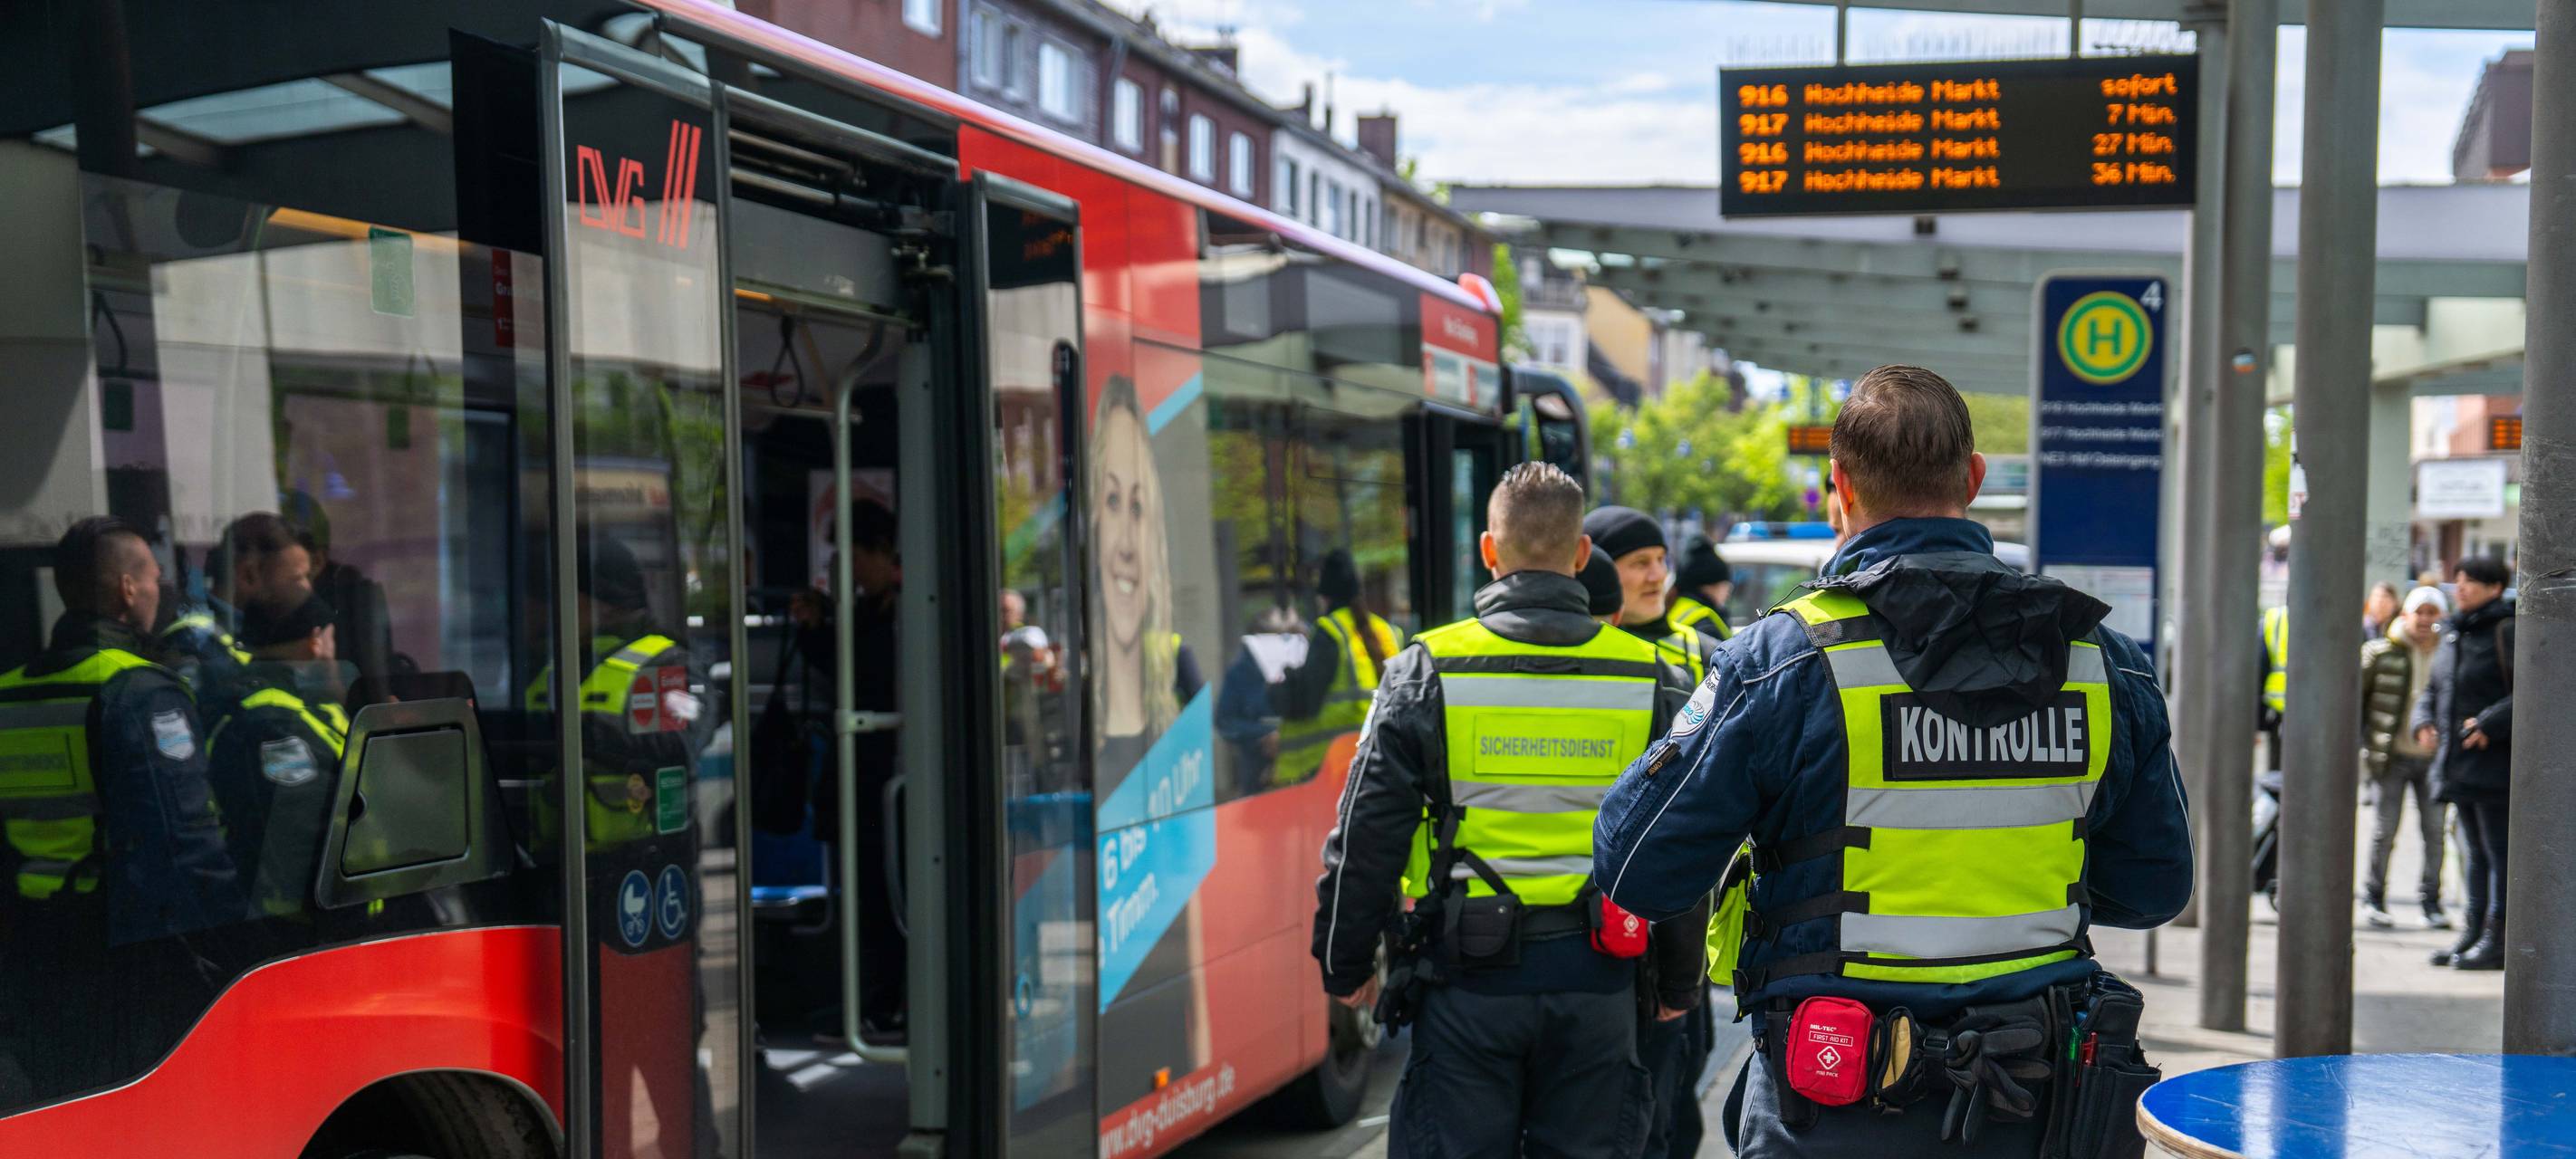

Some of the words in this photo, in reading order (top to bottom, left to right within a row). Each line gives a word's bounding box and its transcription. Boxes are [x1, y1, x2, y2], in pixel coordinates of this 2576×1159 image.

[1739, 84, 1789, 107] 916
[1803, 81, 1925, 106] Hochheide
[1930, 79, 2001, 101] Markt
[2100, 72, 2177, 99] sofort
[1739, 113, 1789, 135] 917
[1803, 110, 1925, 133] Hochheide
[1930, 108, 2001, 130] Markt
[2107, 103, 2124, 125] 7
[2128, 102, 2177, 125] Min.
[1739, 141, 1789, 165] 916
[1803, 139, 1925, 163] Hochheide
[1930, 137, 2001, 159] Markt
[2091, 132, 2123, 157] 27
[2127, 132, 2176, 155] Min.
[1739, 170, 1789, 193] 917
[1803, 168, 1925, 192] Hochheide
[1930, 166, 2001, 188] Markt
[2091, 162, 2123, 185] 36
[2127, 162, 2176, 185] Min.
[2140, 281, 2162, 312] 4
[2088, 318, 2123, 357] H
[1480, 736, 1615, 757] SICHERHEITSDIENST
[1102, 837, 1119, 890] 6
[1172, 748, 1203, 806] Uhr
[1813, 1033, 1828, 1041] FIRST
[1830, 1035, 1839, 1043] AID
[1840, 1036, 1849, 1044] KIT
